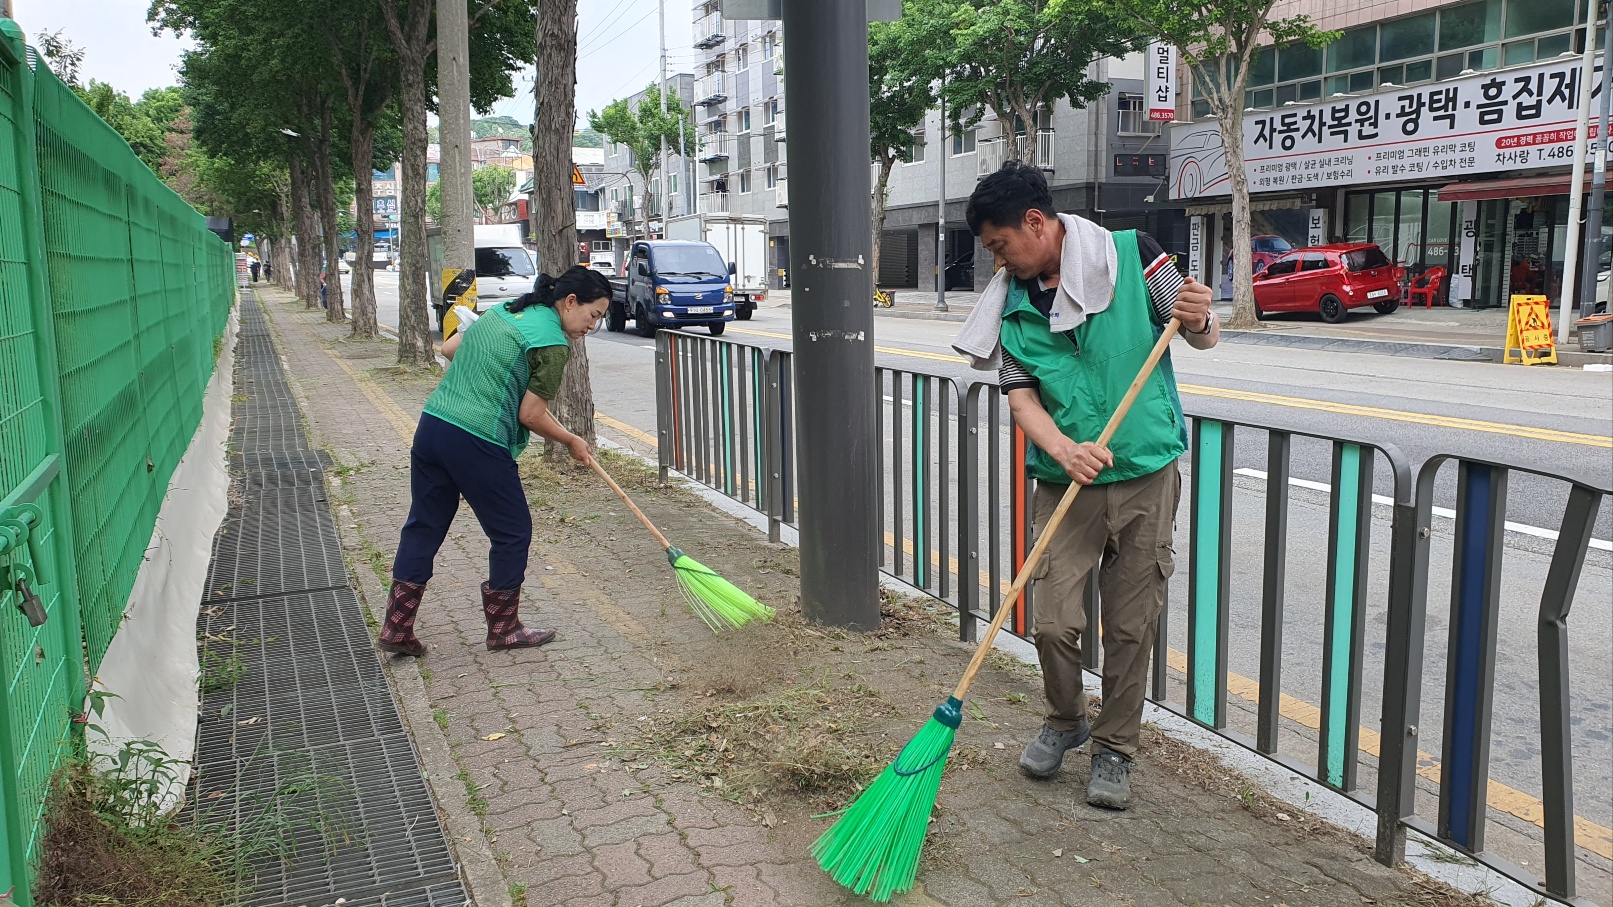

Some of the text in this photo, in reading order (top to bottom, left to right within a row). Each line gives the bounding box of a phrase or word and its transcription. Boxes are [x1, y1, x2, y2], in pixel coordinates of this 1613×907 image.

[1155, 46, 1170, 103] 멀티샵
[1150, 111, 1174, 119] 486.3570
[1501, 137, 1518, 146] 20년
[1520, 135, 1533, 145] 경력
[1535, 132, 1557, 143] 꼼꼼히
[1375, 141, 1476, 161] 프리미엄 그래핀 유리막 코팅
[1495, 149, 1530, 165] 차사랑
[1259, 162, 1284, 174] 프리미엄
[1285, 161, 1298, 172] 광택
[1304, 160, 1317, 170] 살균
[1319, 157, 1332, 168] 실내
[1333, 155, 1354, 166] 크리닝
[1374, 164, 1389, 176] 유리
[1391, 163, 1407, 175] 발수
[1408, 161, 1424, 173] 코팅
[1432, 158, 1457, 170] 수입차
[1459, 156, 1476, 168] 전문
[1259, 176, 1271, 187] 외형
[1272, 175, 1285, 185] 복원
[1326, 169, 1353, 180] 보험수리
